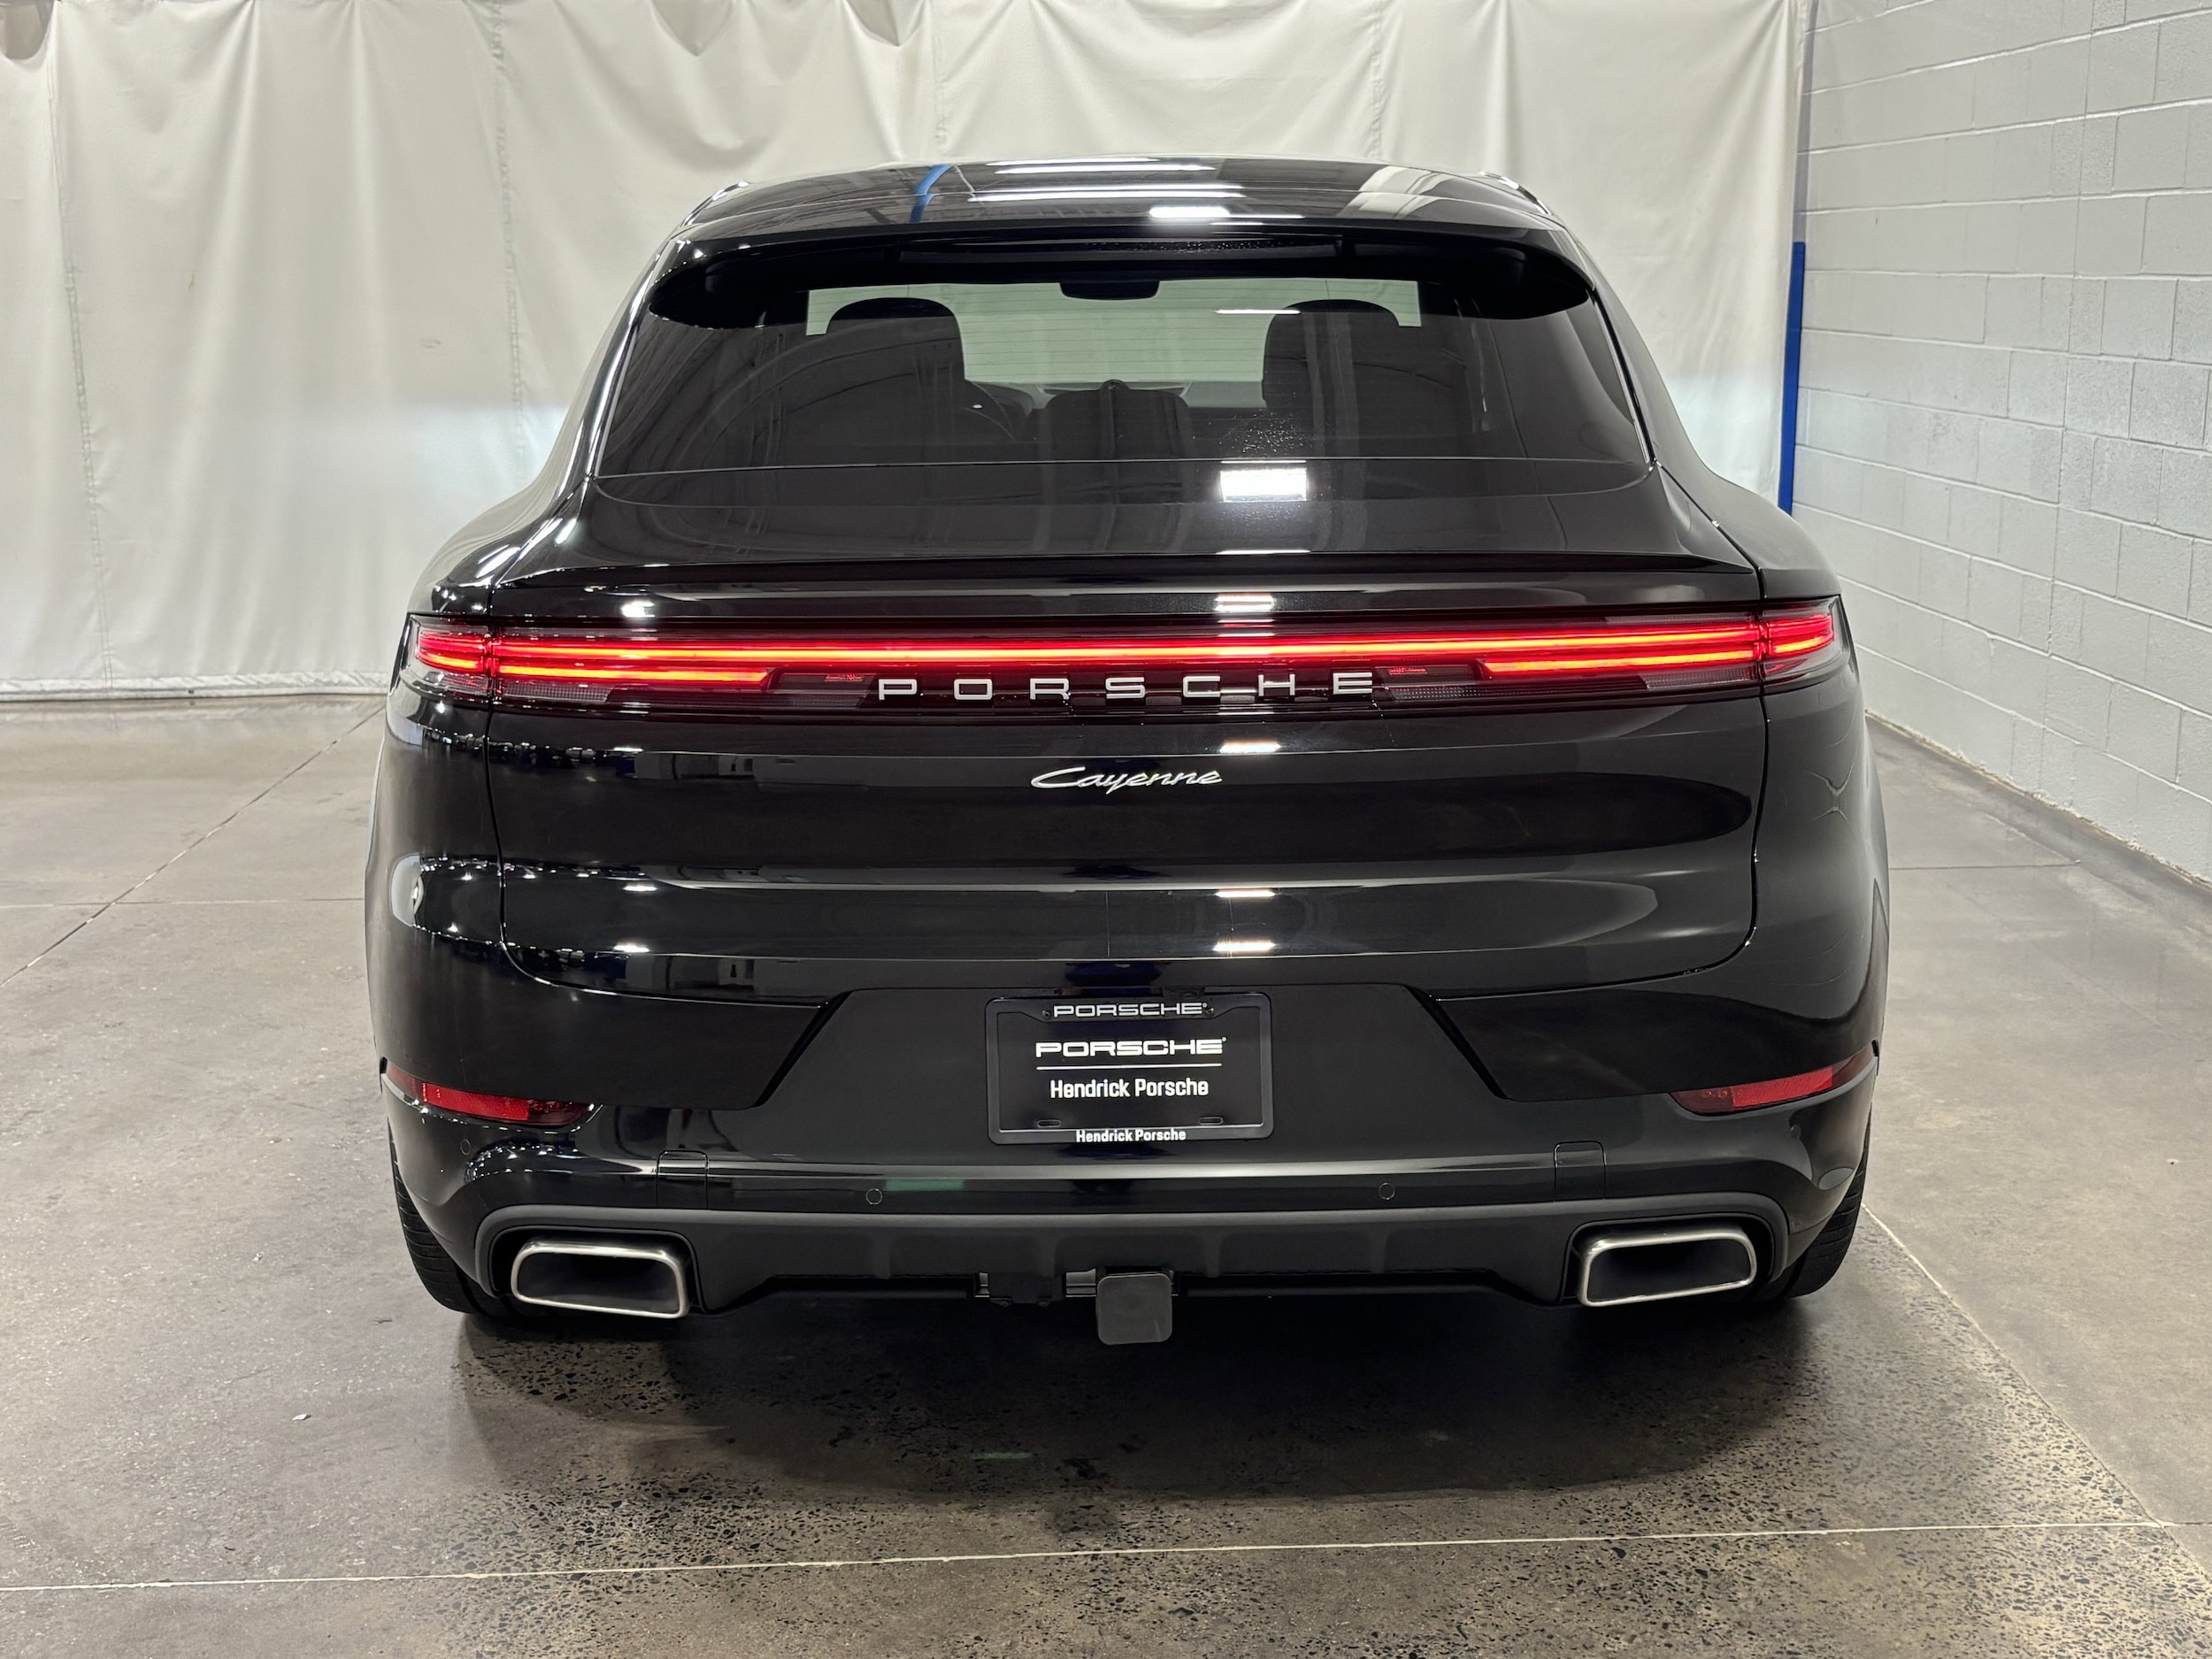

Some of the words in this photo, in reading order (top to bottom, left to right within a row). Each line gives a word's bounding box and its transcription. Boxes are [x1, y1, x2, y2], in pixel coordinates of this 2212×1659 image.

[878, 672, 1373, 702] PORSCHE
[1031, 766, 1223, 795] Cayenne
[1053, 1002, 1203, 1018] PORSCHE
[1035, 1038, 1224, 1058] PORSCHE
[1049, 1079, 1131, 1099] Hendrick
[1134, 1077, 1210, 1097] Porsche
[1075, 1129, 1133, 1143] Hendrick
[1134, 1127, 1187, 1141] Porsche
